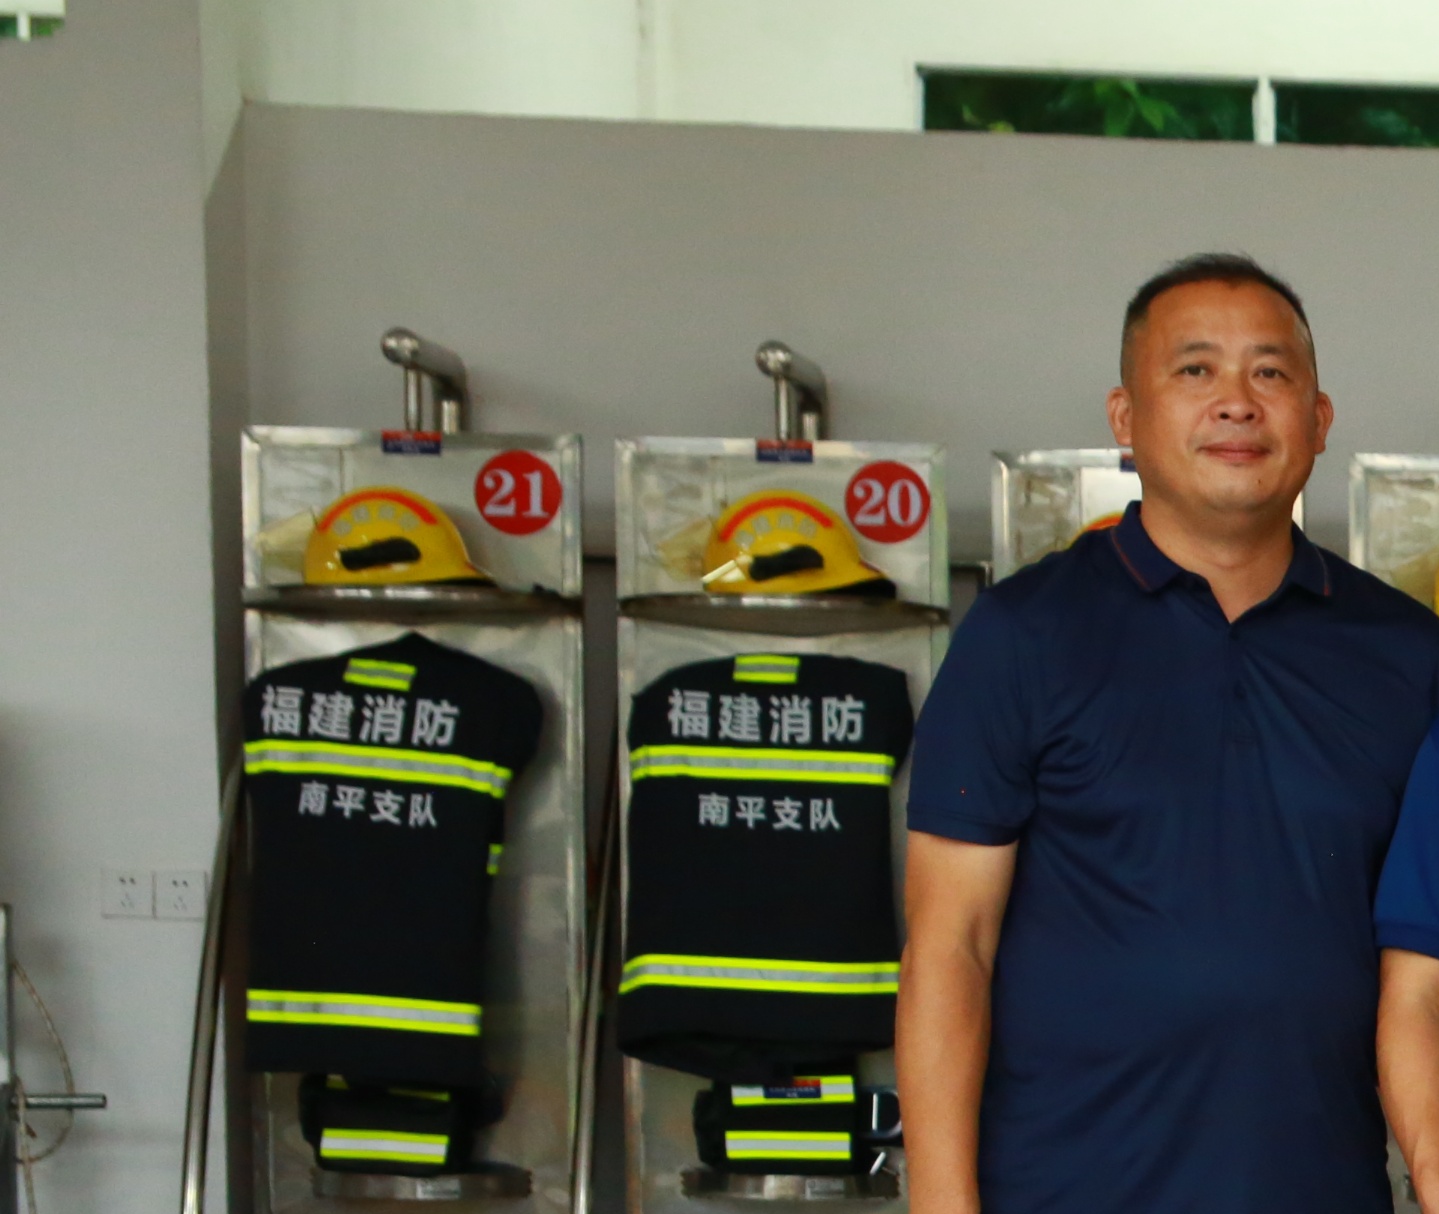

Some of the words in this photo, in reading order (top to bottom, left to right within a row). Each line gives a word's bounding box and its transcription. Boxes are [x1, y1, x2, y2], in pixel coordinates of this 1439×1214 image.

[483, 468, 549, 518] 21
[853, 478, 922, 526] 20
[260, 684, 460, 747] 福建消防
[667, 687, 865, 744] 福建消防
[298, 780, 438, 828] 南平支队
[698, 792, 841, 831] 南平支队
